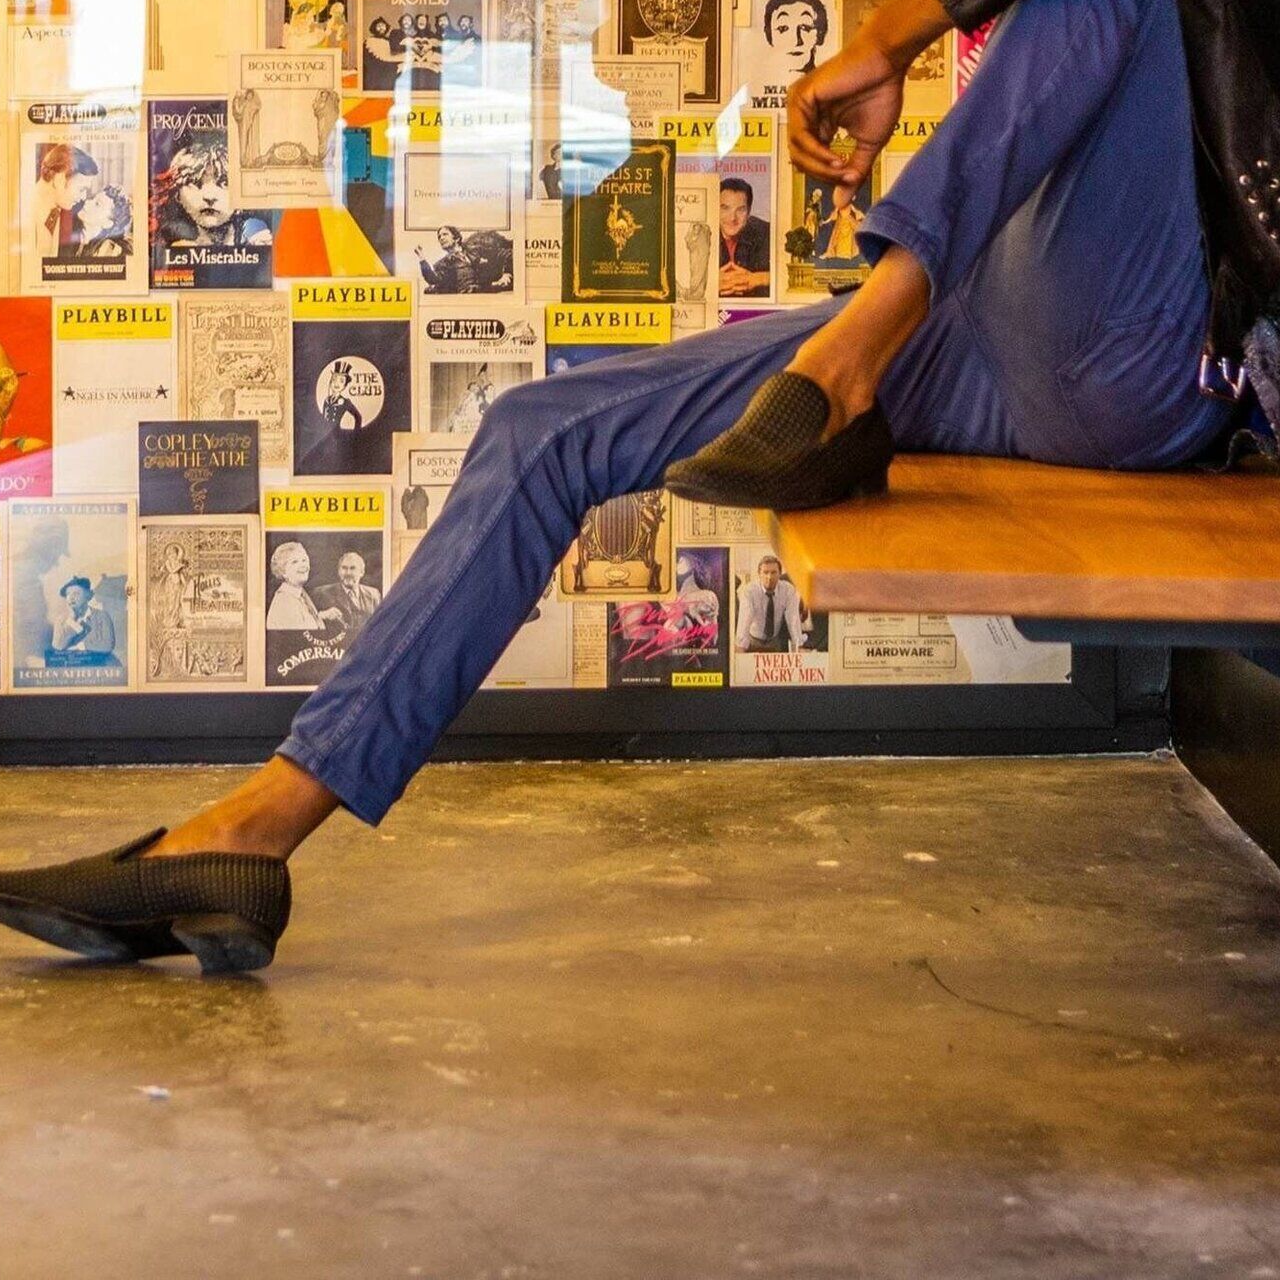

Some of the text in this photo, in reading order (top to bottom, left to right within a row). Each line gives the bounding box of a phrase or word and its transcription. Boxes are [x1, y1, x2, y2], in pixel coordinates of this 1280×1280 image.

[22, 27, 72, 41] Aspects
[248, 61, 326, 71] BOSTON STAGE
[264, 73, 311, 83] SOCIETY
[714, 160, 767, 174] Patinkin
[165, 245, 259, 265] Les Misérables
[298, 287, 406, 303] PLAYBILL
[62, 308, 167, 324] PLAYBILL
[554, 312, 660, 327] PLAYBILL
[441, 322, 500, 340] PLAYBILL
[353, 371, 379, 383] THE
[349, 383, 382, 397] CLUB
[145, 433, 212, 451] COPLEY
[172, 451, 251, 468] THEATRE
[416, 456, 460, 467] BOSTON
[271, 497, 380, 512] PLAYBILL
[866, 646, 935, 657] HARDWARE
[754, 654, 804, 668] TWELVE
[674, 674, 722, 684] PLAYBILL
[753, 668, 825, 684] ANGRY MEN
